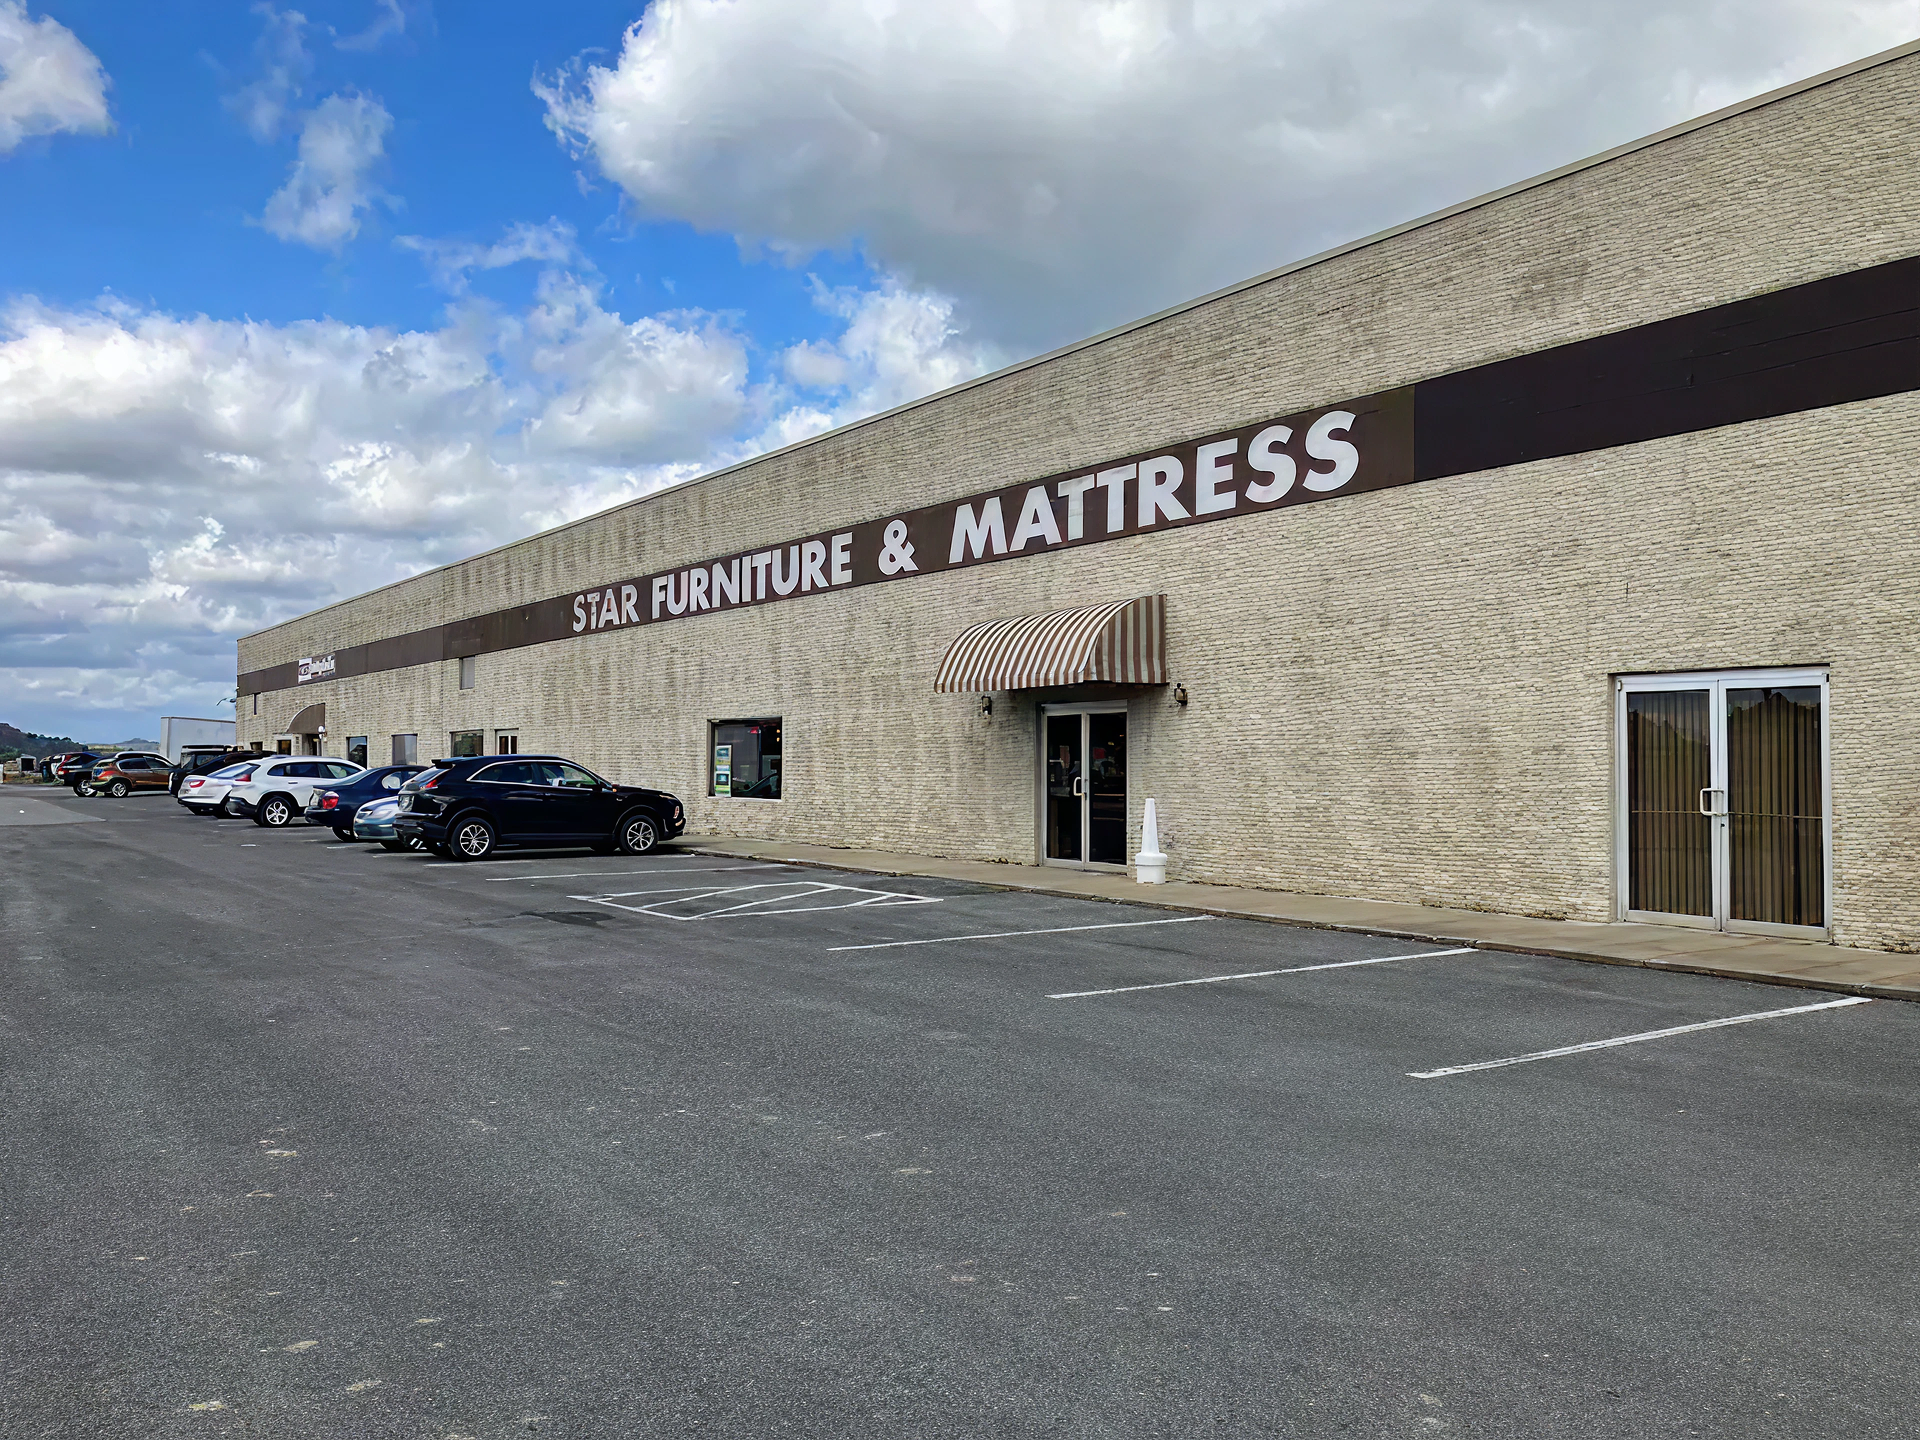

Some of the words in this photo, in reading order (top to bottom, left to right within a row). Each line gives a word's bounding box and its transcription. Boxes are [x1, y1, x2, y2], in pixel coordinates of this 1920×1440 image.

[572, 585, 640, 632] STAR
[651, 532, 853, 620] FURNITURE
[878, 519, 920, 576] &
[948, 410, 1360, 564] MATTRESS
